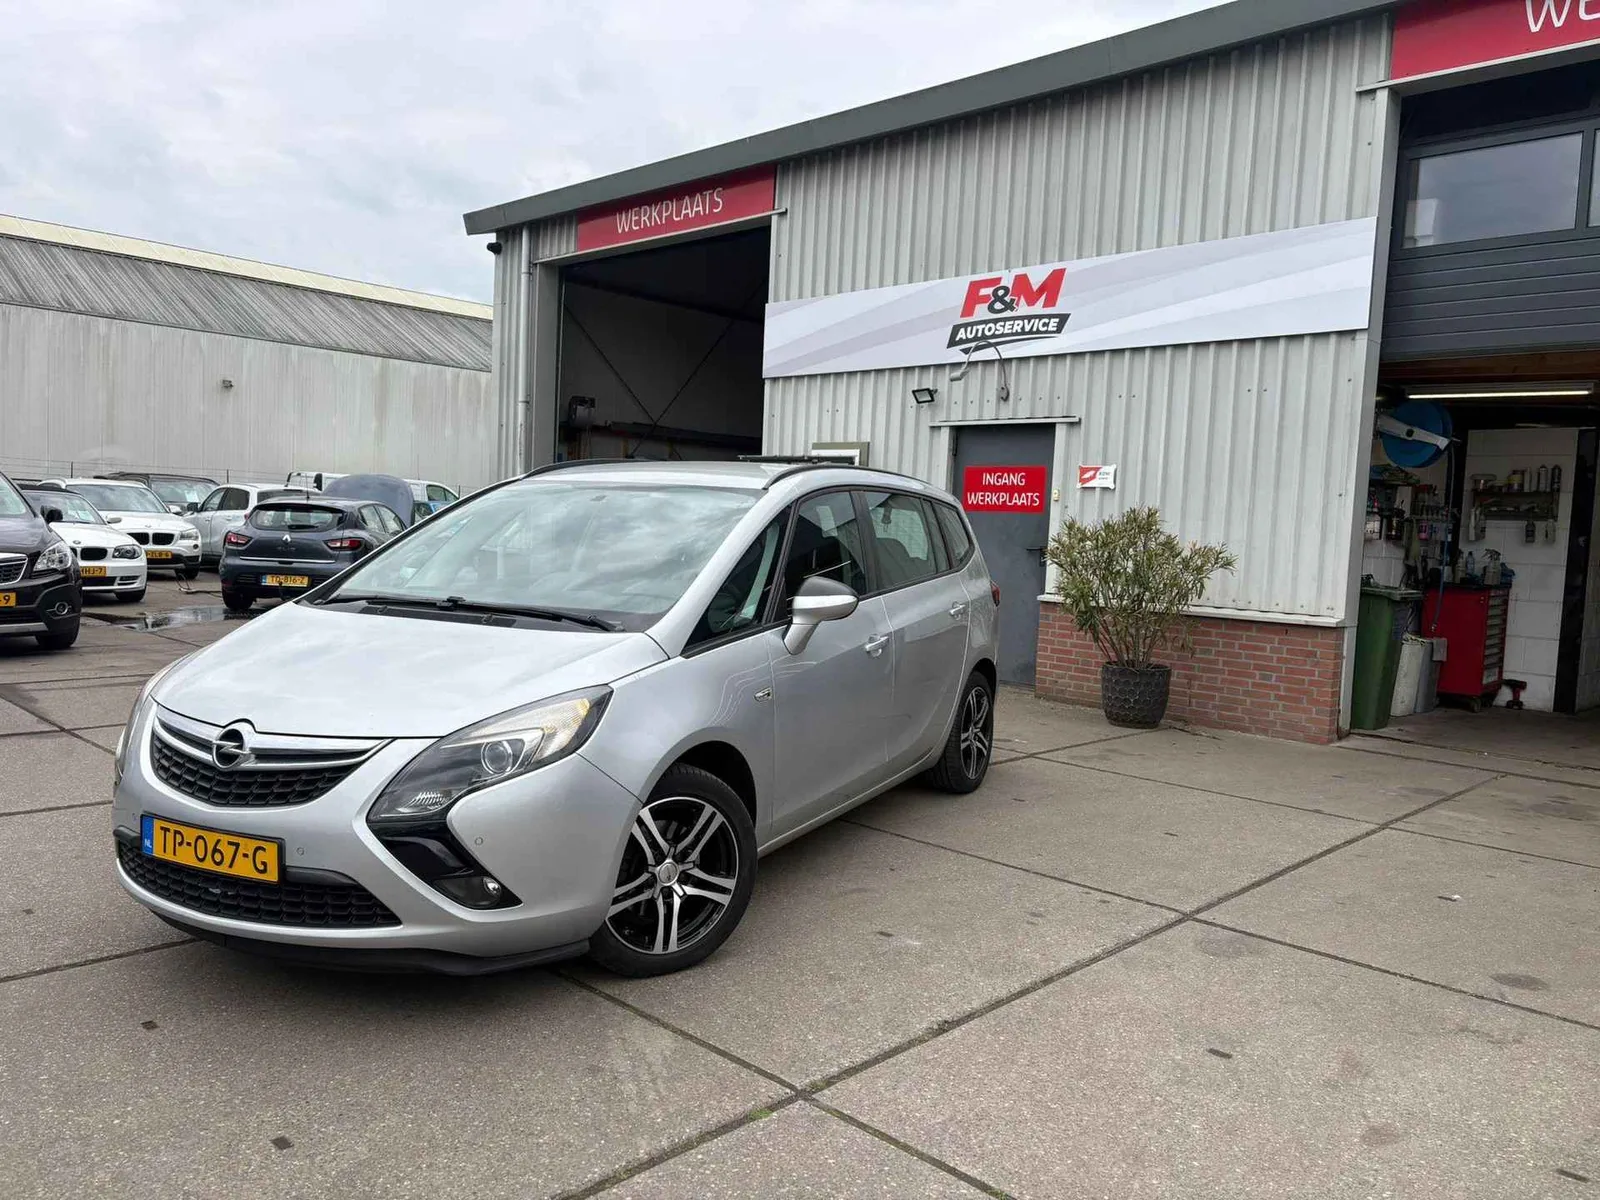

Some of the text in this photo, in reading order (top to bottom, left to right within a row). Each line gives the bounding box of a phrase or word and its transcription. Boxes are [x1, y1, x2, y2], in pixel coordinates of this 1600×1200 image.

[616, 187, 724, 234] WERKPLAATS
[960, 267, 1067, 319] F&M
[955, 318, 1060, 341] AUTOSERVICE
[982, 472, 1026, 486] INGANG
[967, 492, 1040, 506] WERKPLAATS
[159, 825, 268, 875] TP-067-G
